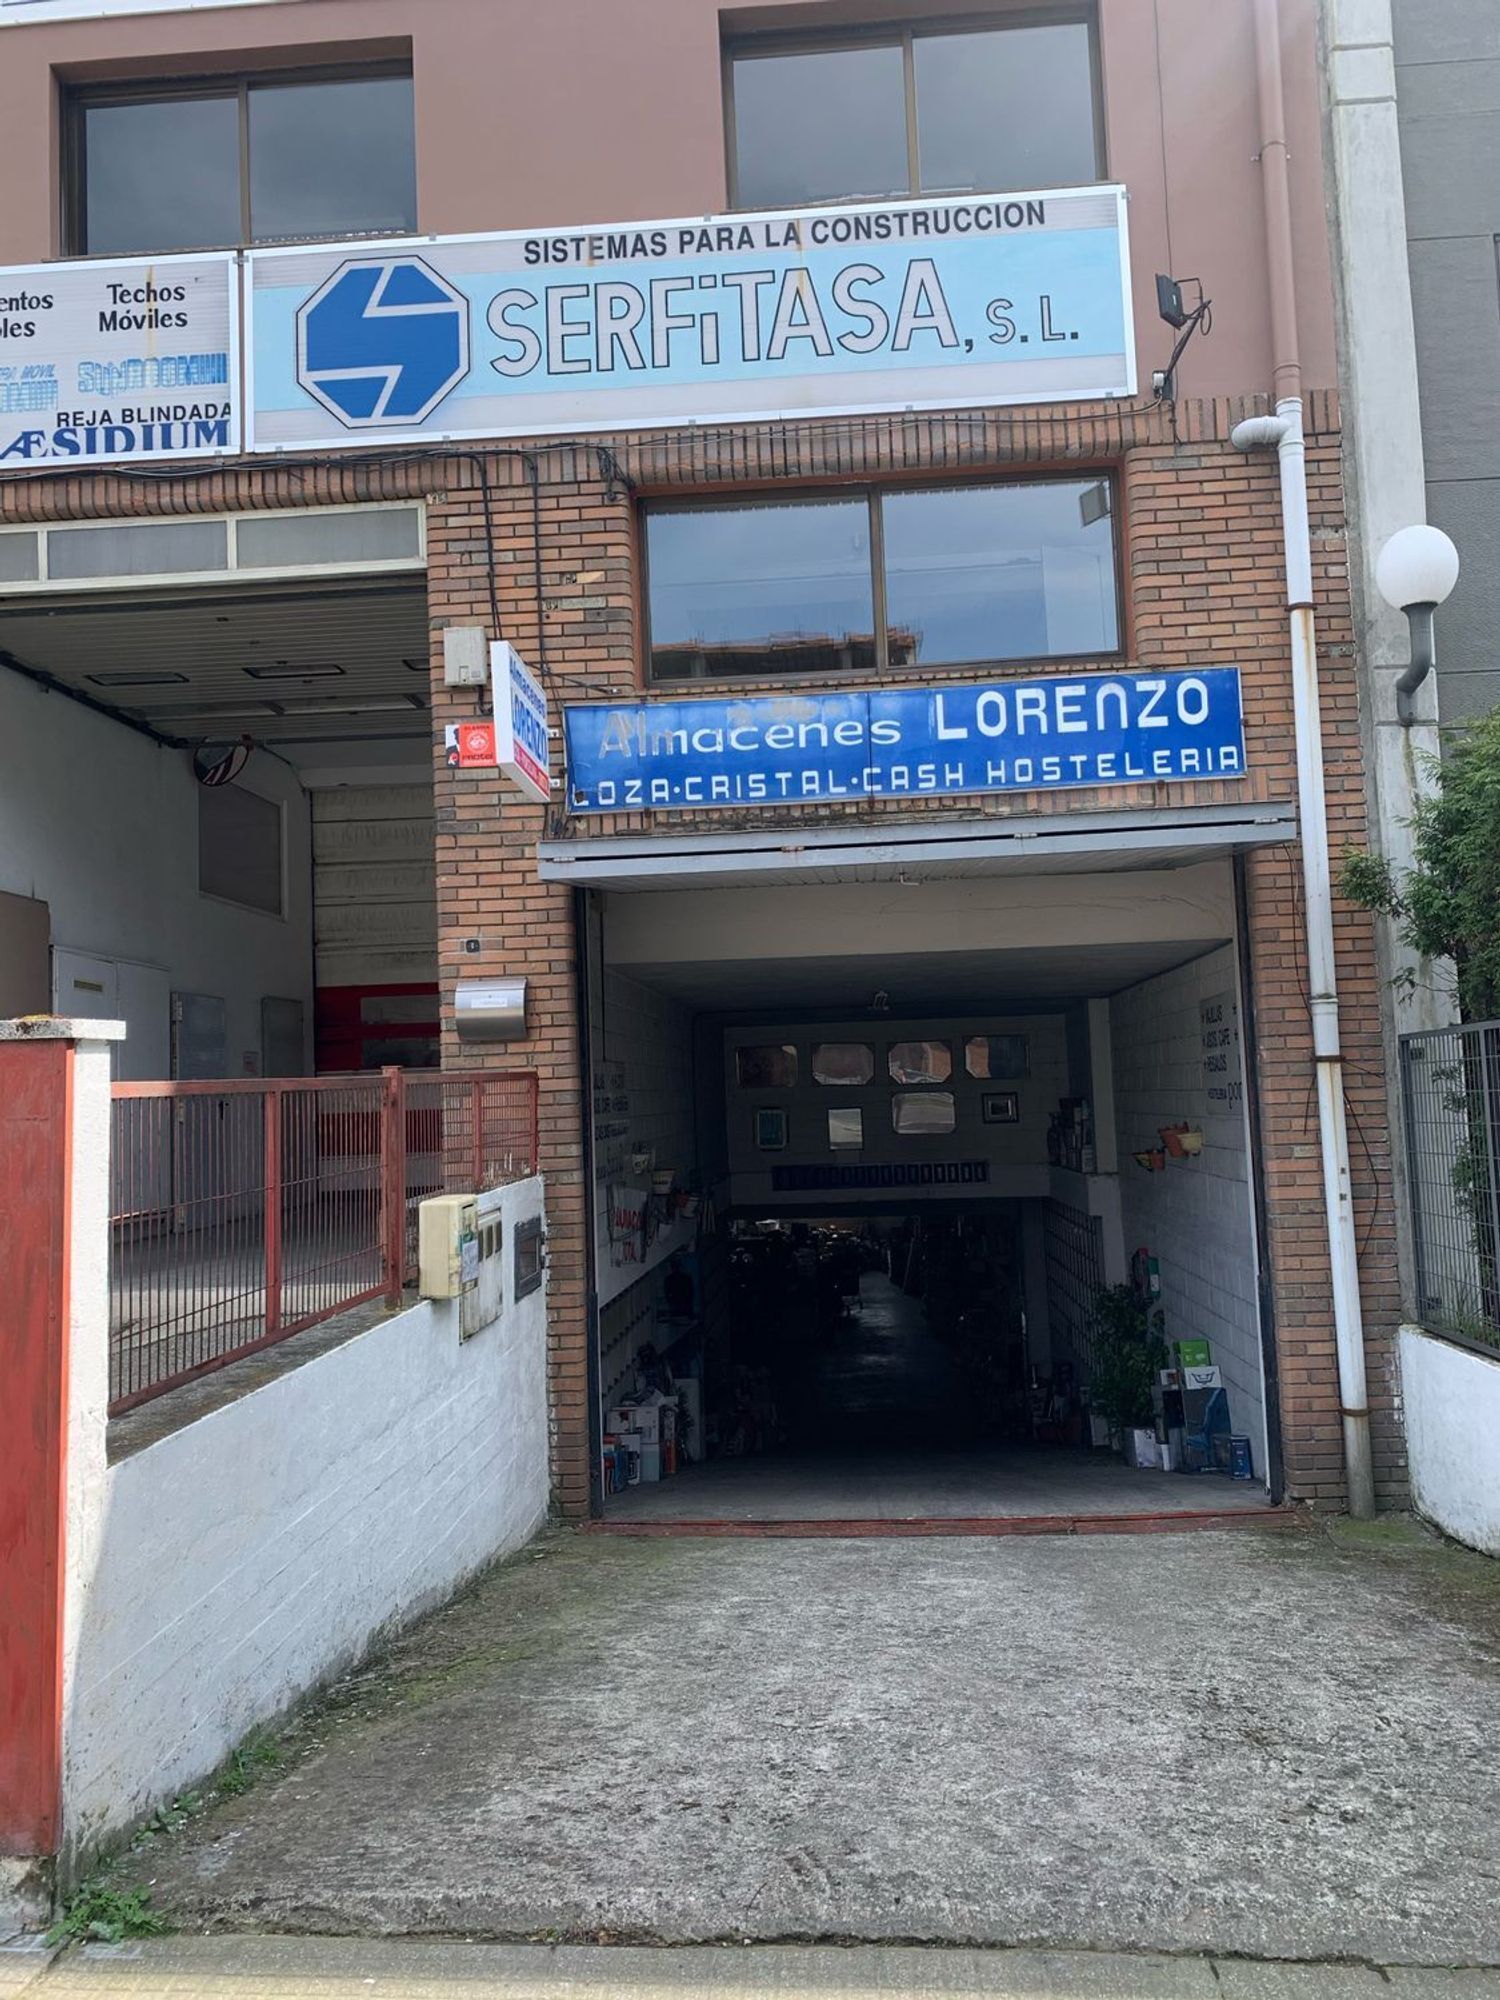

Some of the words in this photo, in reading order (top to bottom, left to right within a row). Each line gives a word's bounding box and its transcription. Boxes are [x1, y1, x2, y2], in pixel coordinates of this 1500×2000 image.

[524, 231, 668, 265] SISTEMAS
[679, 225, 756, 254] PARA
[765, 222, 801, 248] LA
[811, 201, 1046, 245] CONSTRUCCION
[107, 282, 187, 305] Techos
[0, 318, 36, 339] les
[98, 308, 188, 333] Móviles
[56, 410, 114, 428] REJA
[121, 402, 231, 424] BLINDADA
[598, 709, 902, 759] Almacenes
[935, 677, 1210, 741] LORENZO
[987, 746, 1239, 784] HOSTELERIA
